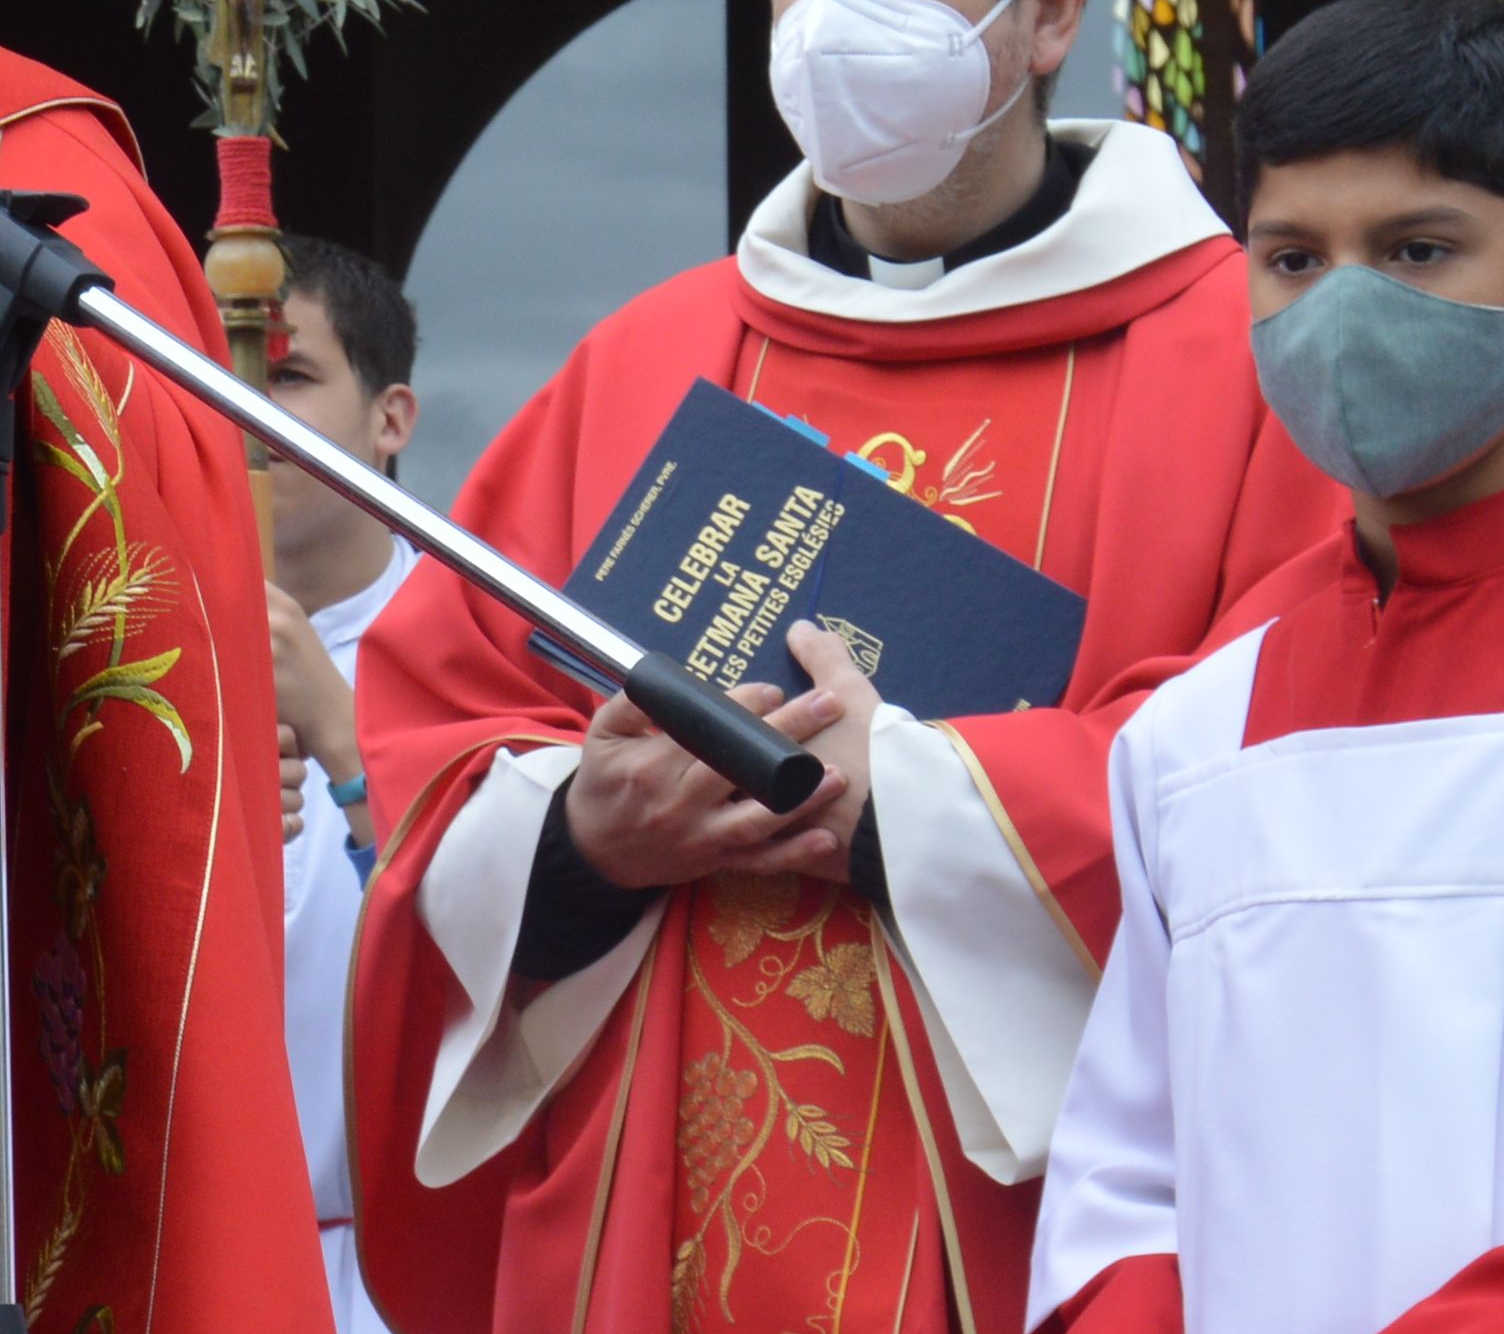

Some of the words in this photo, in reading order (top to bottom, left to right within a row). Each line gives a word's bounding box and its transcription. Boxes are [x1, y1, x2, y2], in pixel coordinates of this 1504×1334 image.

[653, 493, 751, 624] CELEBRAR
[713, 561, 741, 587] LA
[755, 485, 825, 568] SANTA
[716, 654, 749, 689] LES
[736, 587, 790, 658] PETITES
[778, 499, 846, 591] ESGLÉSIES
